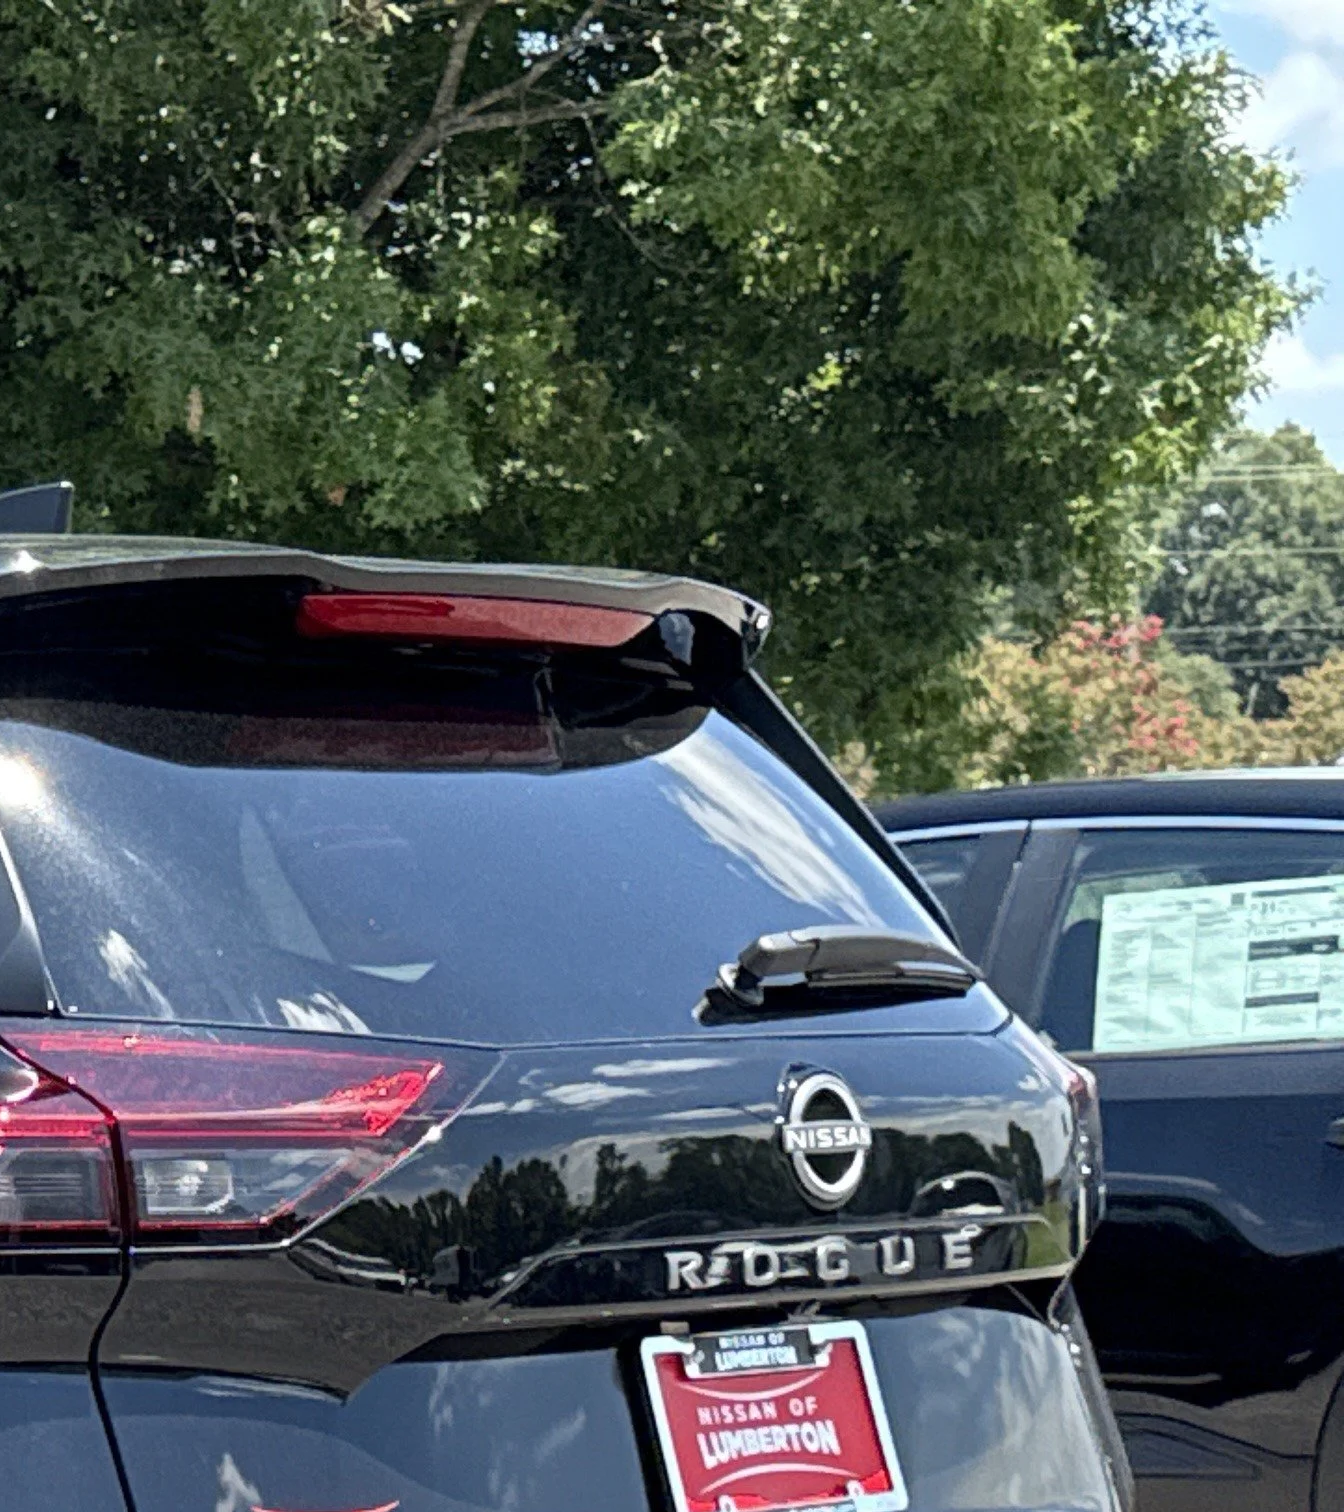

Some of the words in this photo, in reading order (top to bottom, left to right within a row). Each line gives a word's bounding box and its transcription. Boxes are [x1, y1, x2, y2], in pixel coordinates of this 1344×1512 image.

[785, 1122, 870, 1150] NISSAN
[664, 1231, 974, 1291] ROGUE
[696, 1401, 778, 1425] NISSAN
[789, 1396, 818, 1417] OF
[696, 1419, 842, 1470] LUMBERTON
